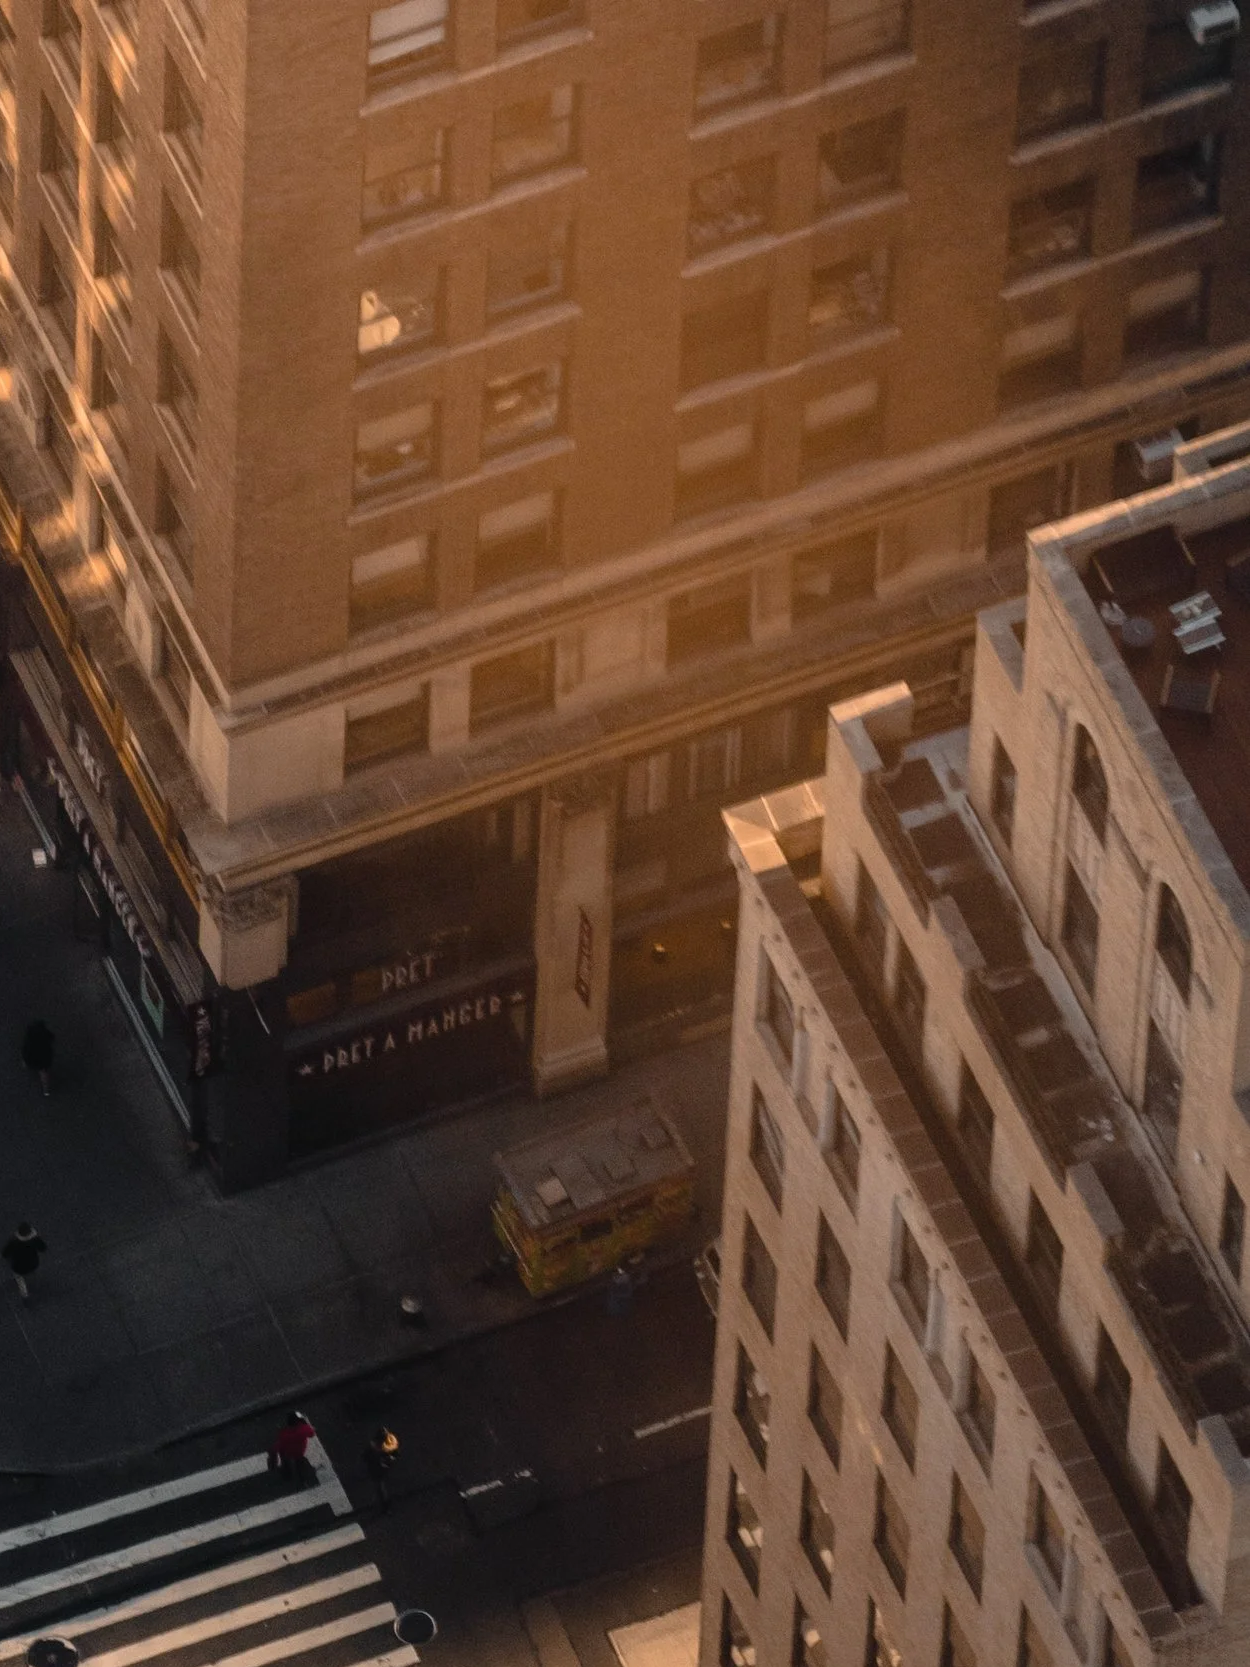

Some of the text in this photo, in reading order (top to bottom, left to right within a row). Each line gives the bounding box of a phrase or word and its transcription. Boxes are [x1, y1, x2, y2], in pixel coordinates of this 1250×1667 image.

[323, 995, 502, 1073] PRET A MANGER
